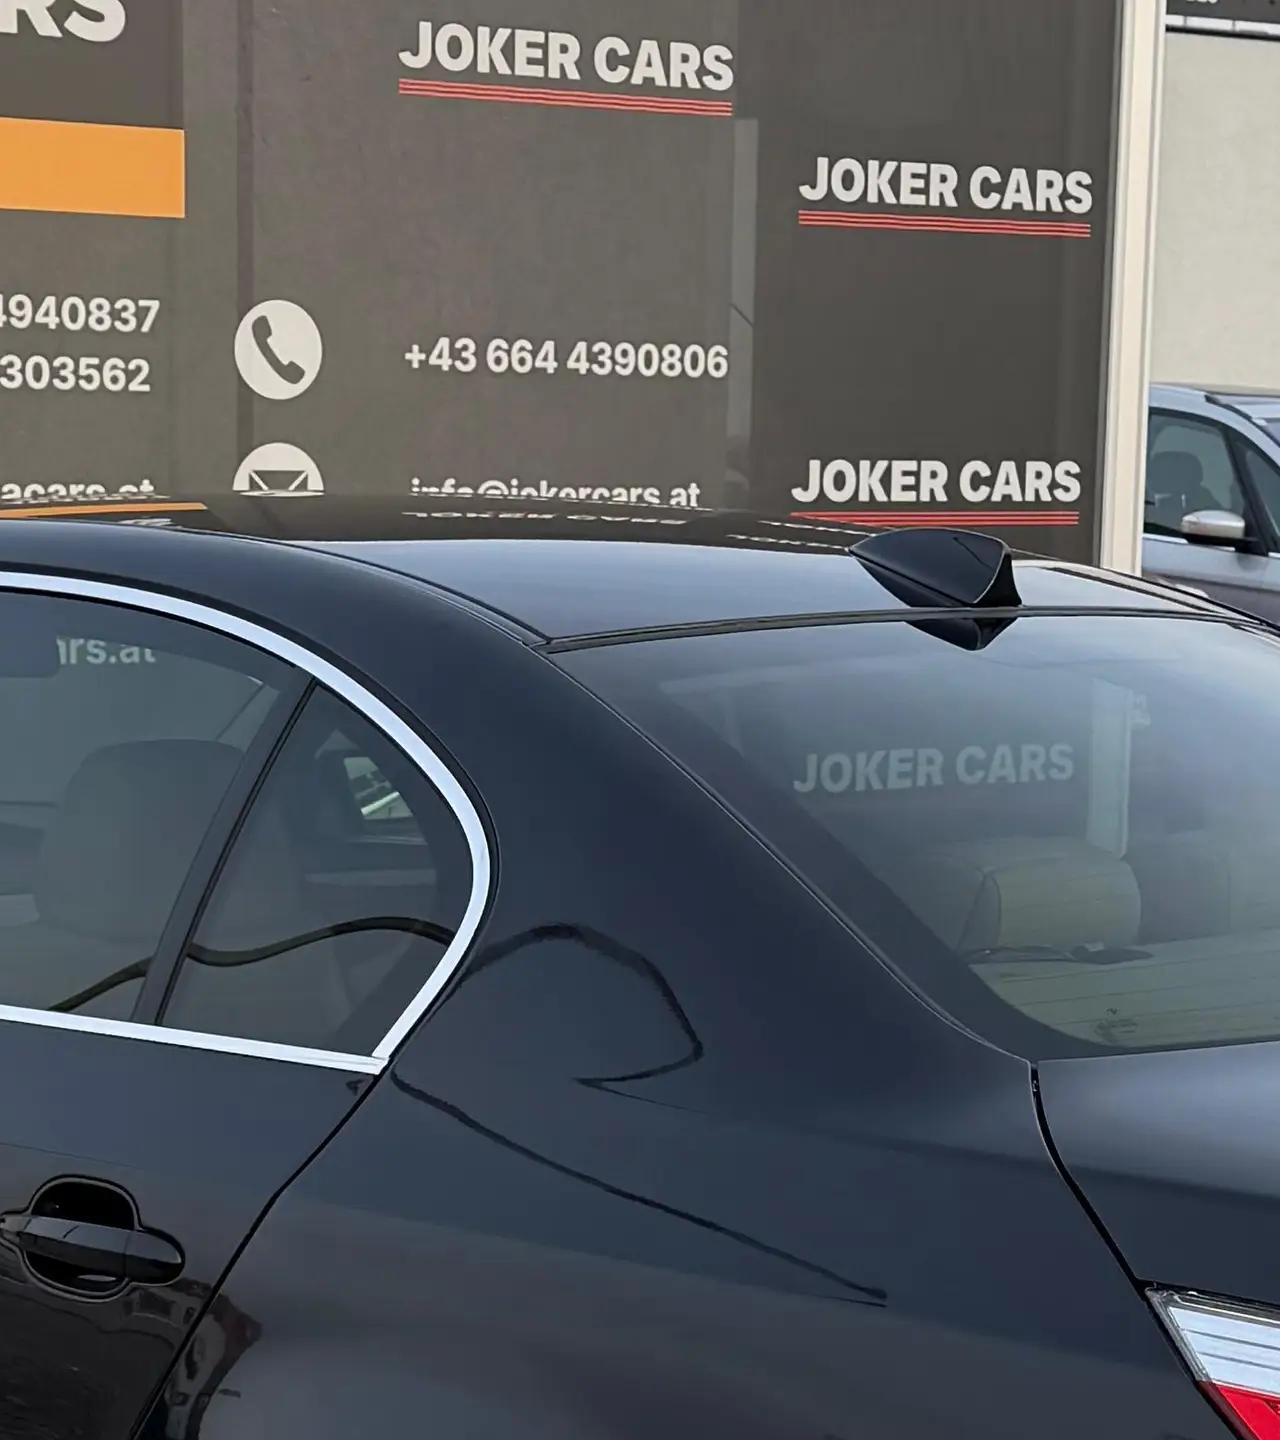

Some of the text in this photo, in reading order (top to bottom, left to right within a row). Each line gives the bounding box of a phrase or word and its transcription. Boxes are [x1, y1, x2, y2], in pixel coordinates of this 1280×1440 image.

[399, 21, 734, 91] JOKER CARS
[799, 156, 1093, 214] JOKER CARS
[0, 354, 151, 392] 303562
[404, 337, 728, 378] +43 664 4390806
[410, 477, 701, 507] @okercarsat
[791, 459, 1081, 502] JOKER CARS
[793, 743, 1075, 793] JOKER CARS
